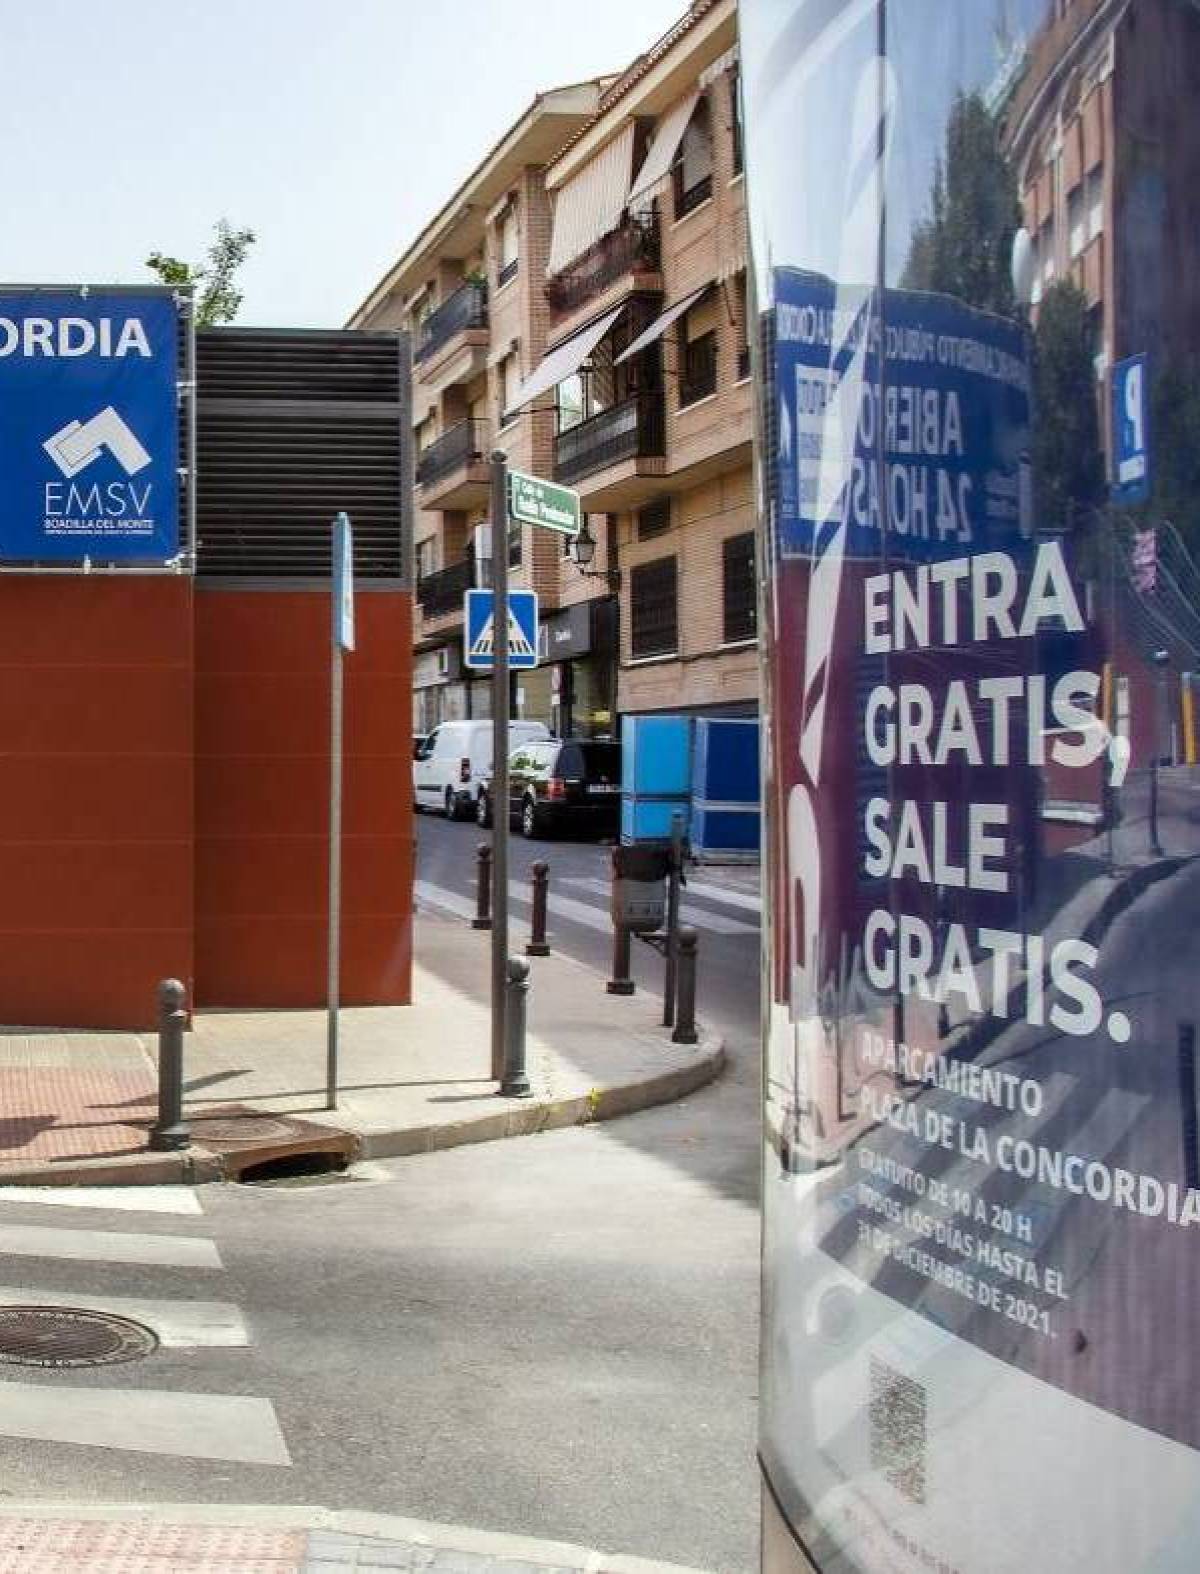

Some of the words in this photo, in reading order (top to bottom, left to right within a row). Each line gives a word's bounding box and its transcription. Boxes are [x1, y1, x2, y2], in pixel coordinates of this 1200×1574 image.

[45, 482, 152, 516] EMSV
[864, 541, 1085, 655] ENTRA
[864, 671, 1131, 787] GRATIS,
[864, 797, 1009, 893] SALE
[864, 909, 1132, 1043] GRATIS.
[924, 1109, 953, 1148] DE
[959, 1121, 991, 1165] LA
[996, 1135, 1200, 1228] CONCORDIA
[975, 1200, 987, 1224] A
[991, 1205, 1012, 1233] 20
[1016, 1215, 1032, 1242] H
[977, 1240, 1039, 1288] HASTA
[1044, 1267, 1070, 1301] EL
[977, 1280, 1002, 1313] DE
